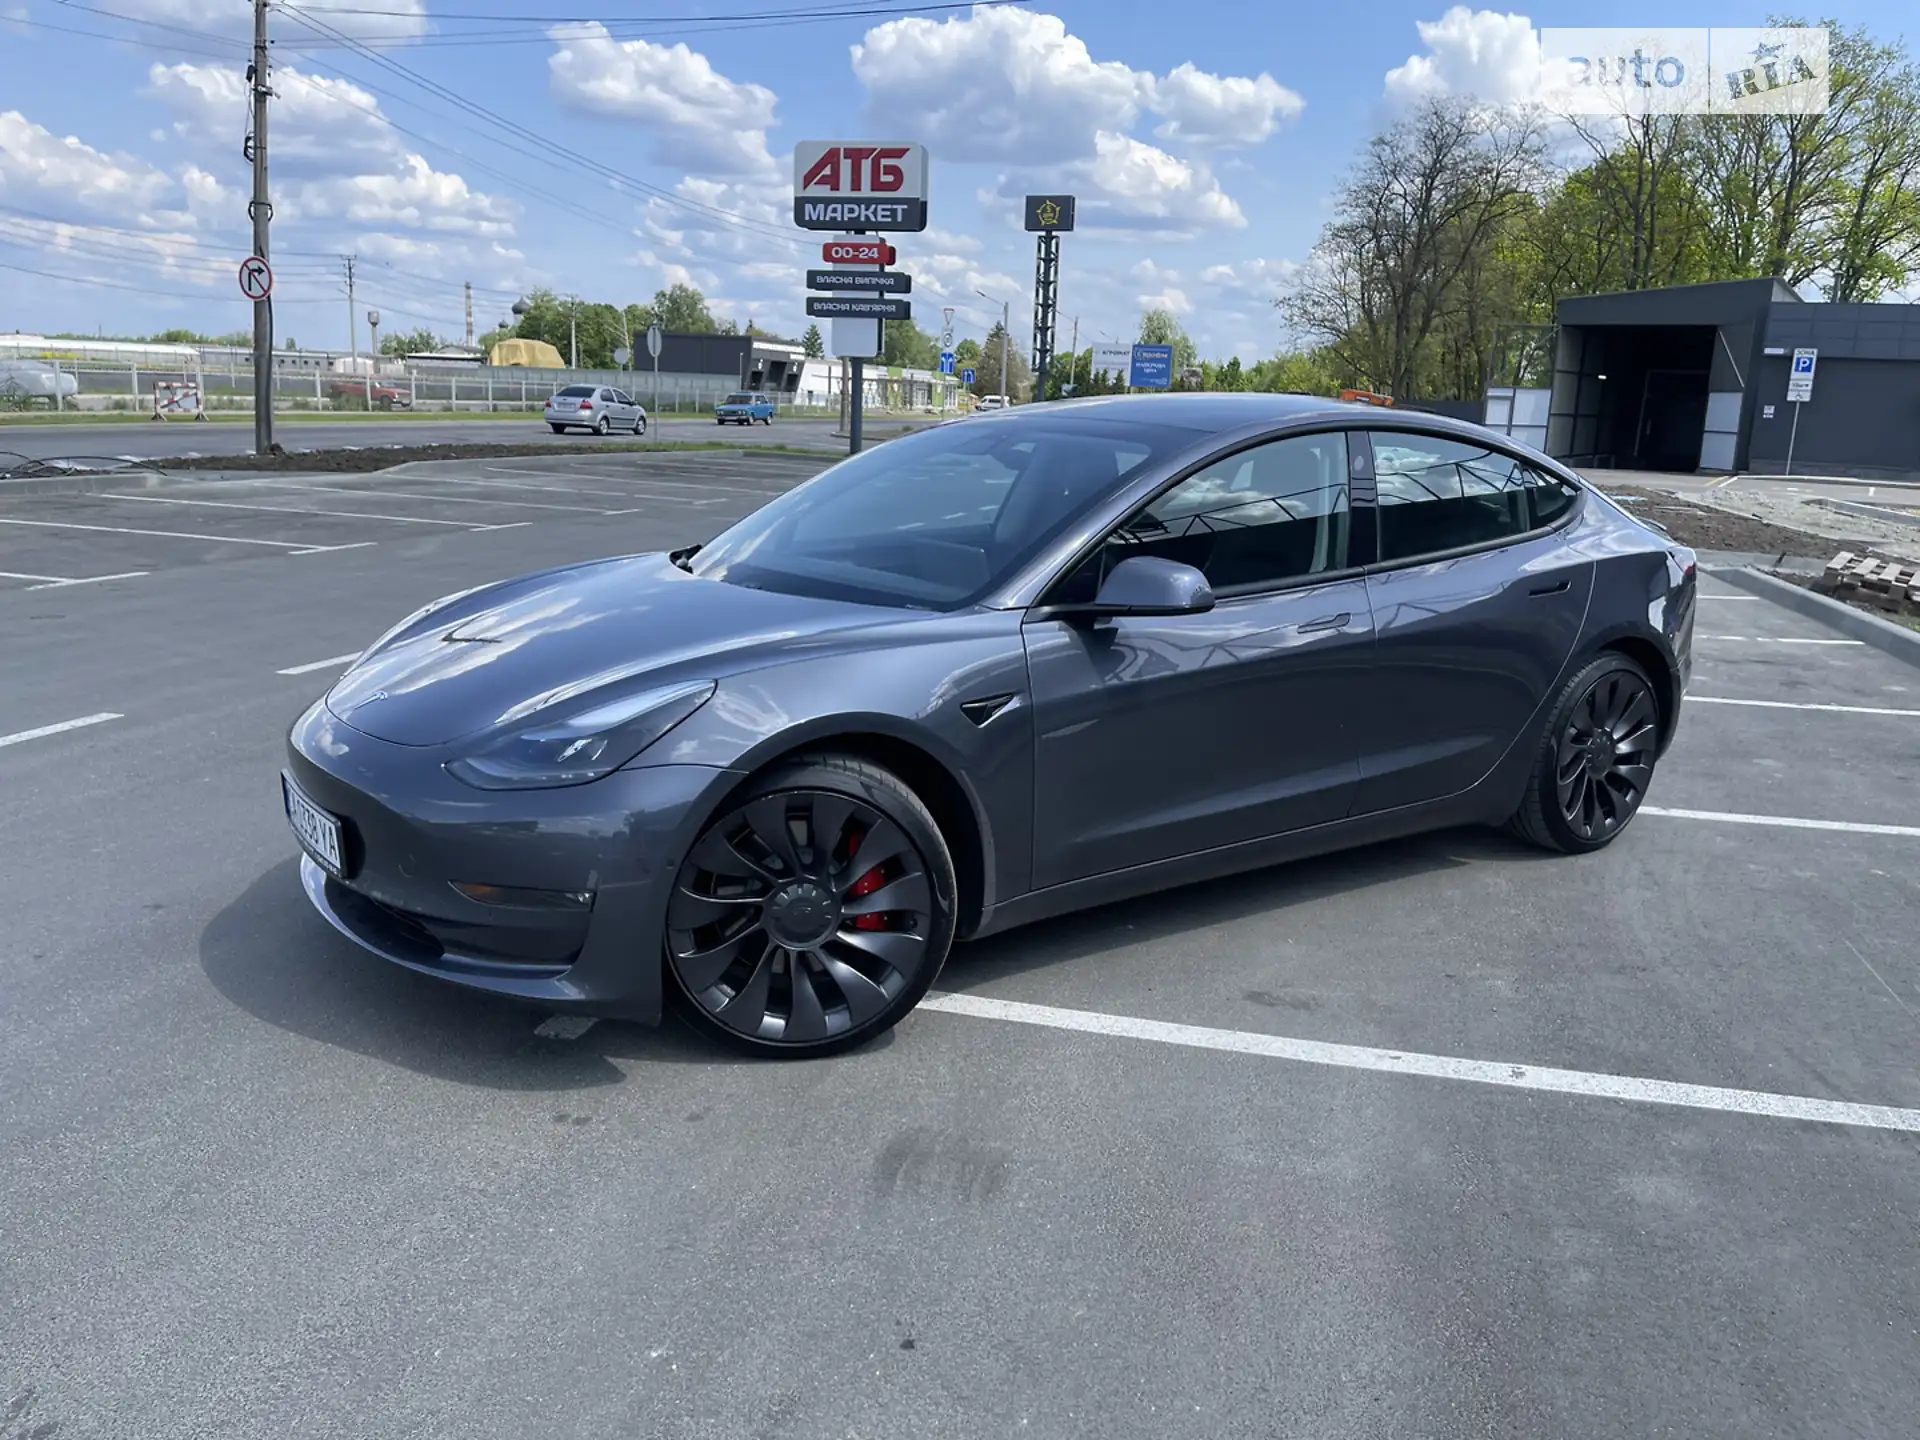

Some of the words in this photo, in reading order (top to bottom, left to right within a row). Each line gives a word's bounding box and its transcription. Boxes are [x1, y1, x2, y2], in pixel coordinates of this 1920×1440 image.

[803, 148, 910, 192] АТБ
[805, 203, 907, 223] МАРКЕТ
[831, 246, 879, 259] 00-24
[816, 275, 853, 284] ВЛАСНА
[813, 302, 850, 311] ВЛАСНА
